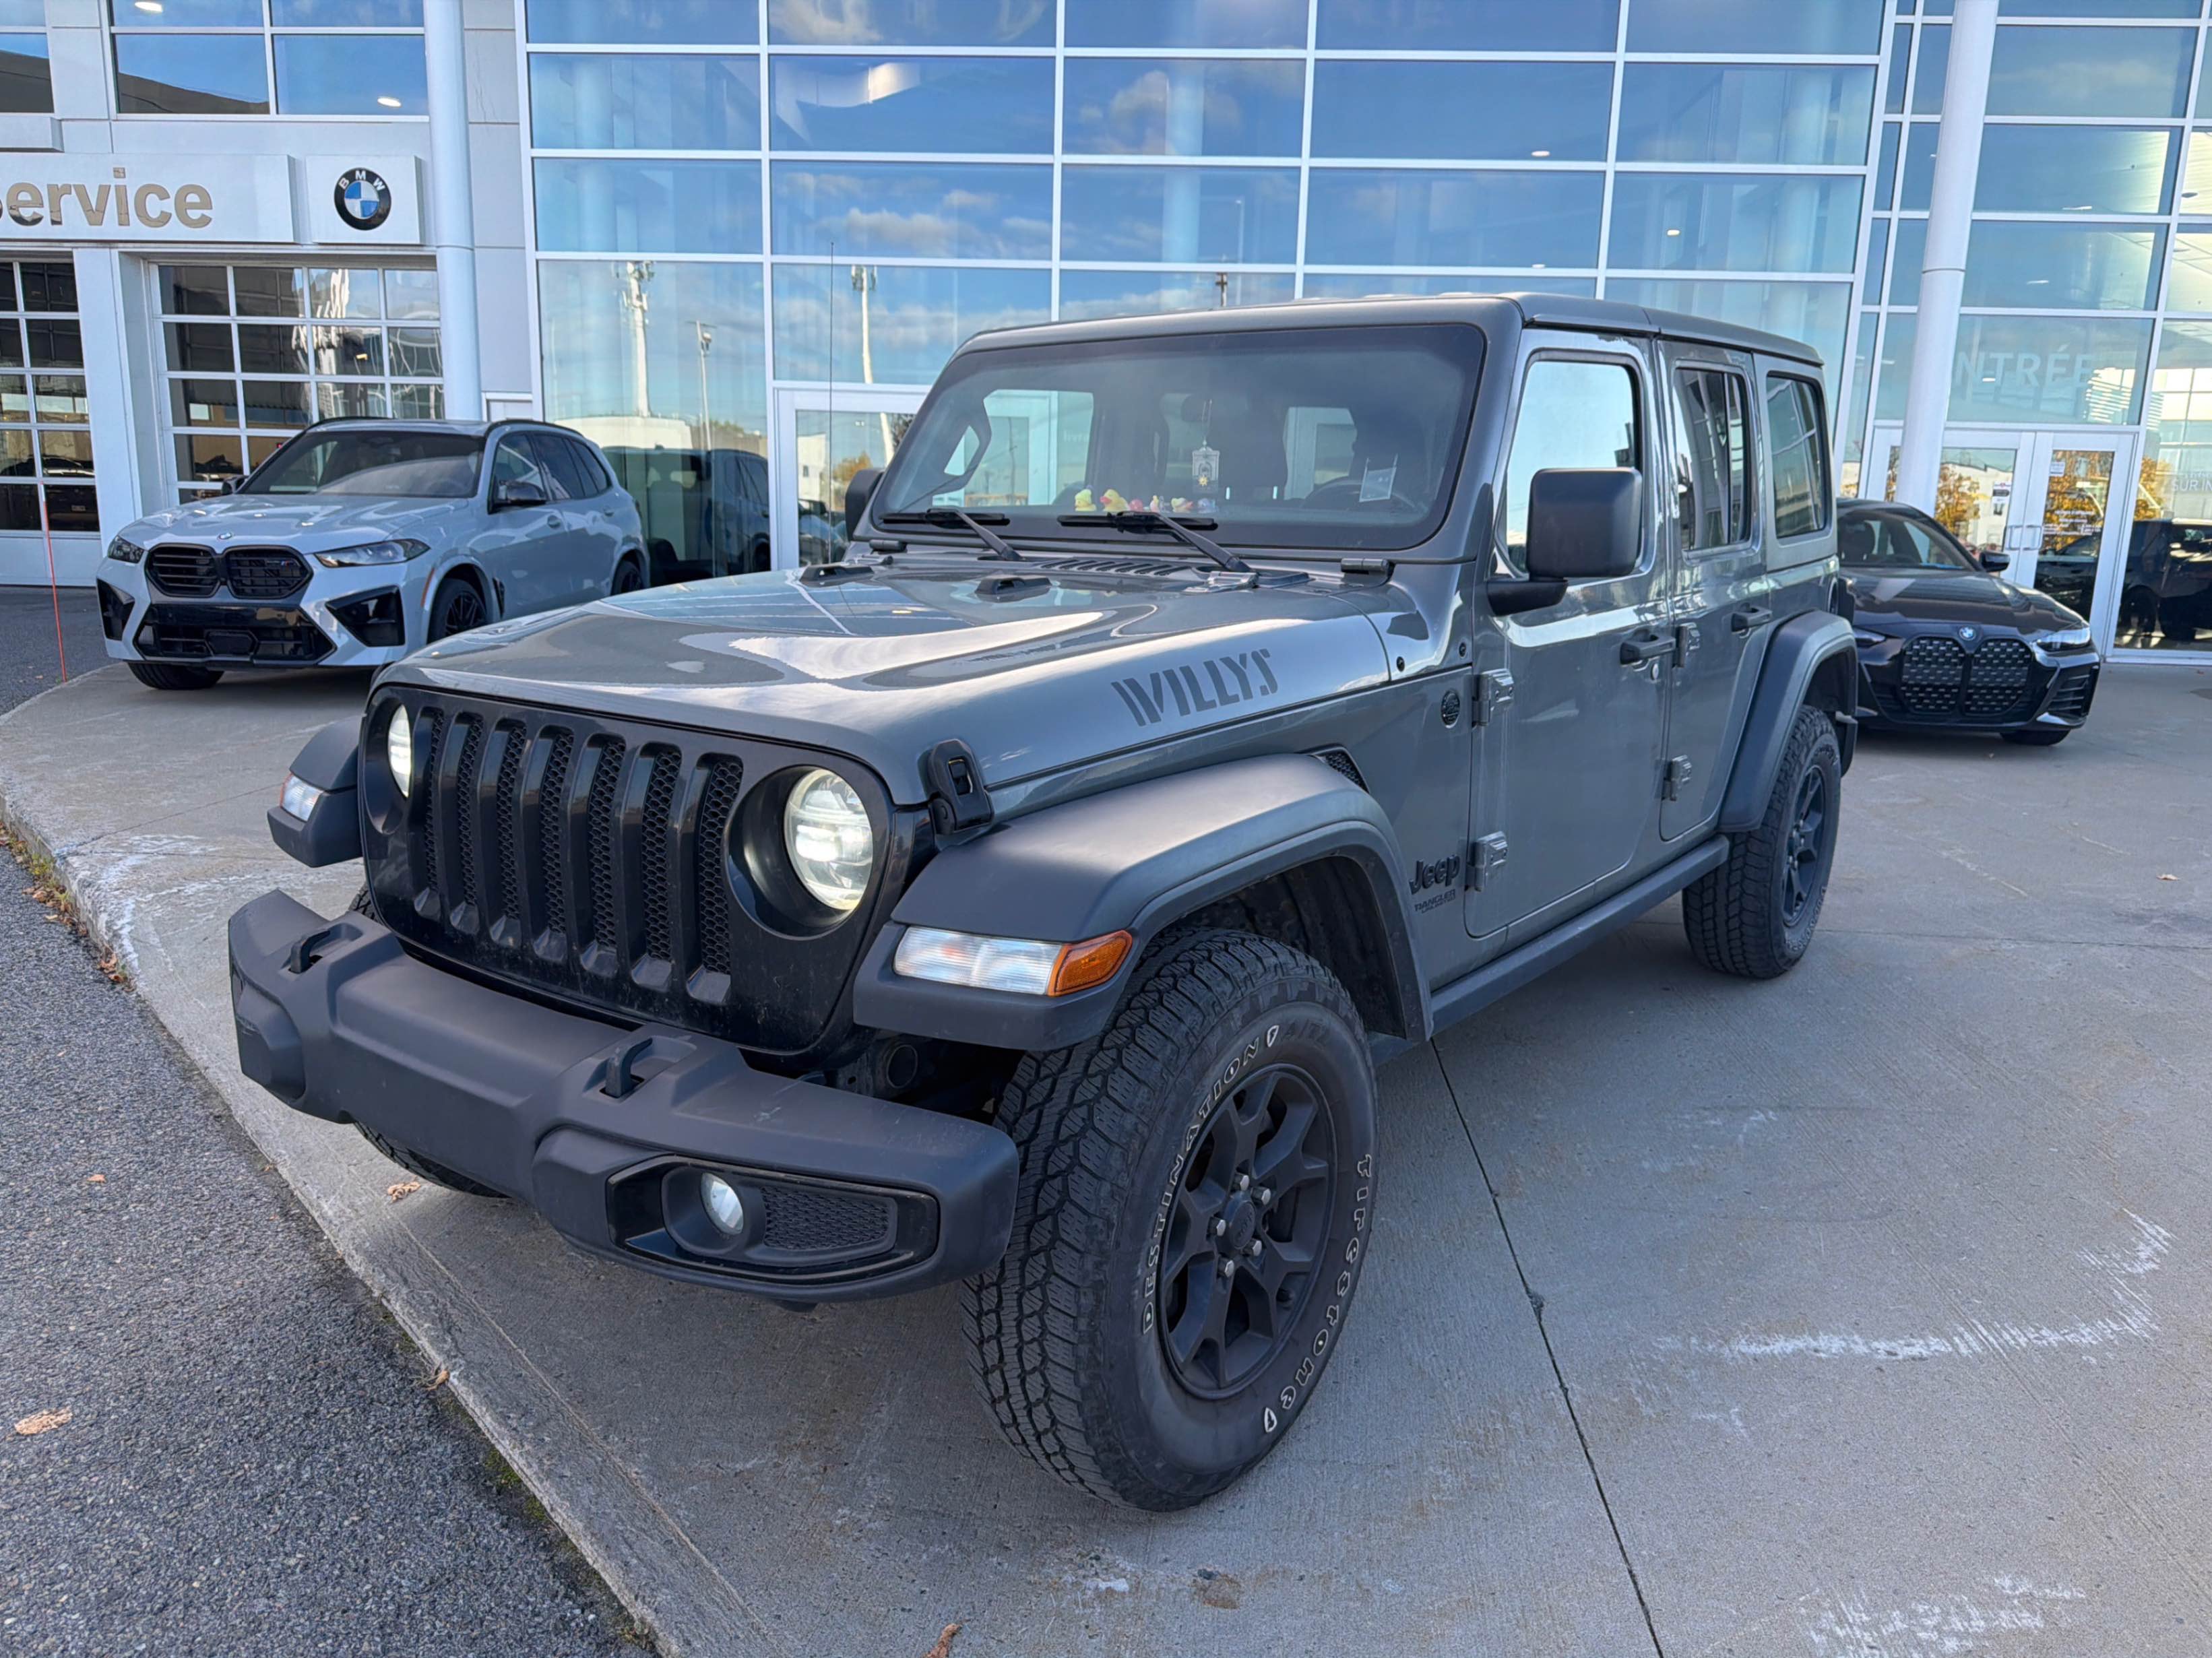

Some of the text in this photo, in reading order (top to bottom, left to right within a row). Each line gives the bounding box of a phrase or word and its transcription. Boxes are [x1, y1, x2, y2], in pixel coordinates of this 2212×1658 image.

[0, 167, 213, 228] ervice
[339, 170, 385, 191] BMW
[1955, 342, 2095, 387] NTRÉE
[1111, 649, 1277, 726] WILLYS
[1409, 855, 1460, 895] Jeep
[1144, 1038, 1259, 1335] DESTINATION
